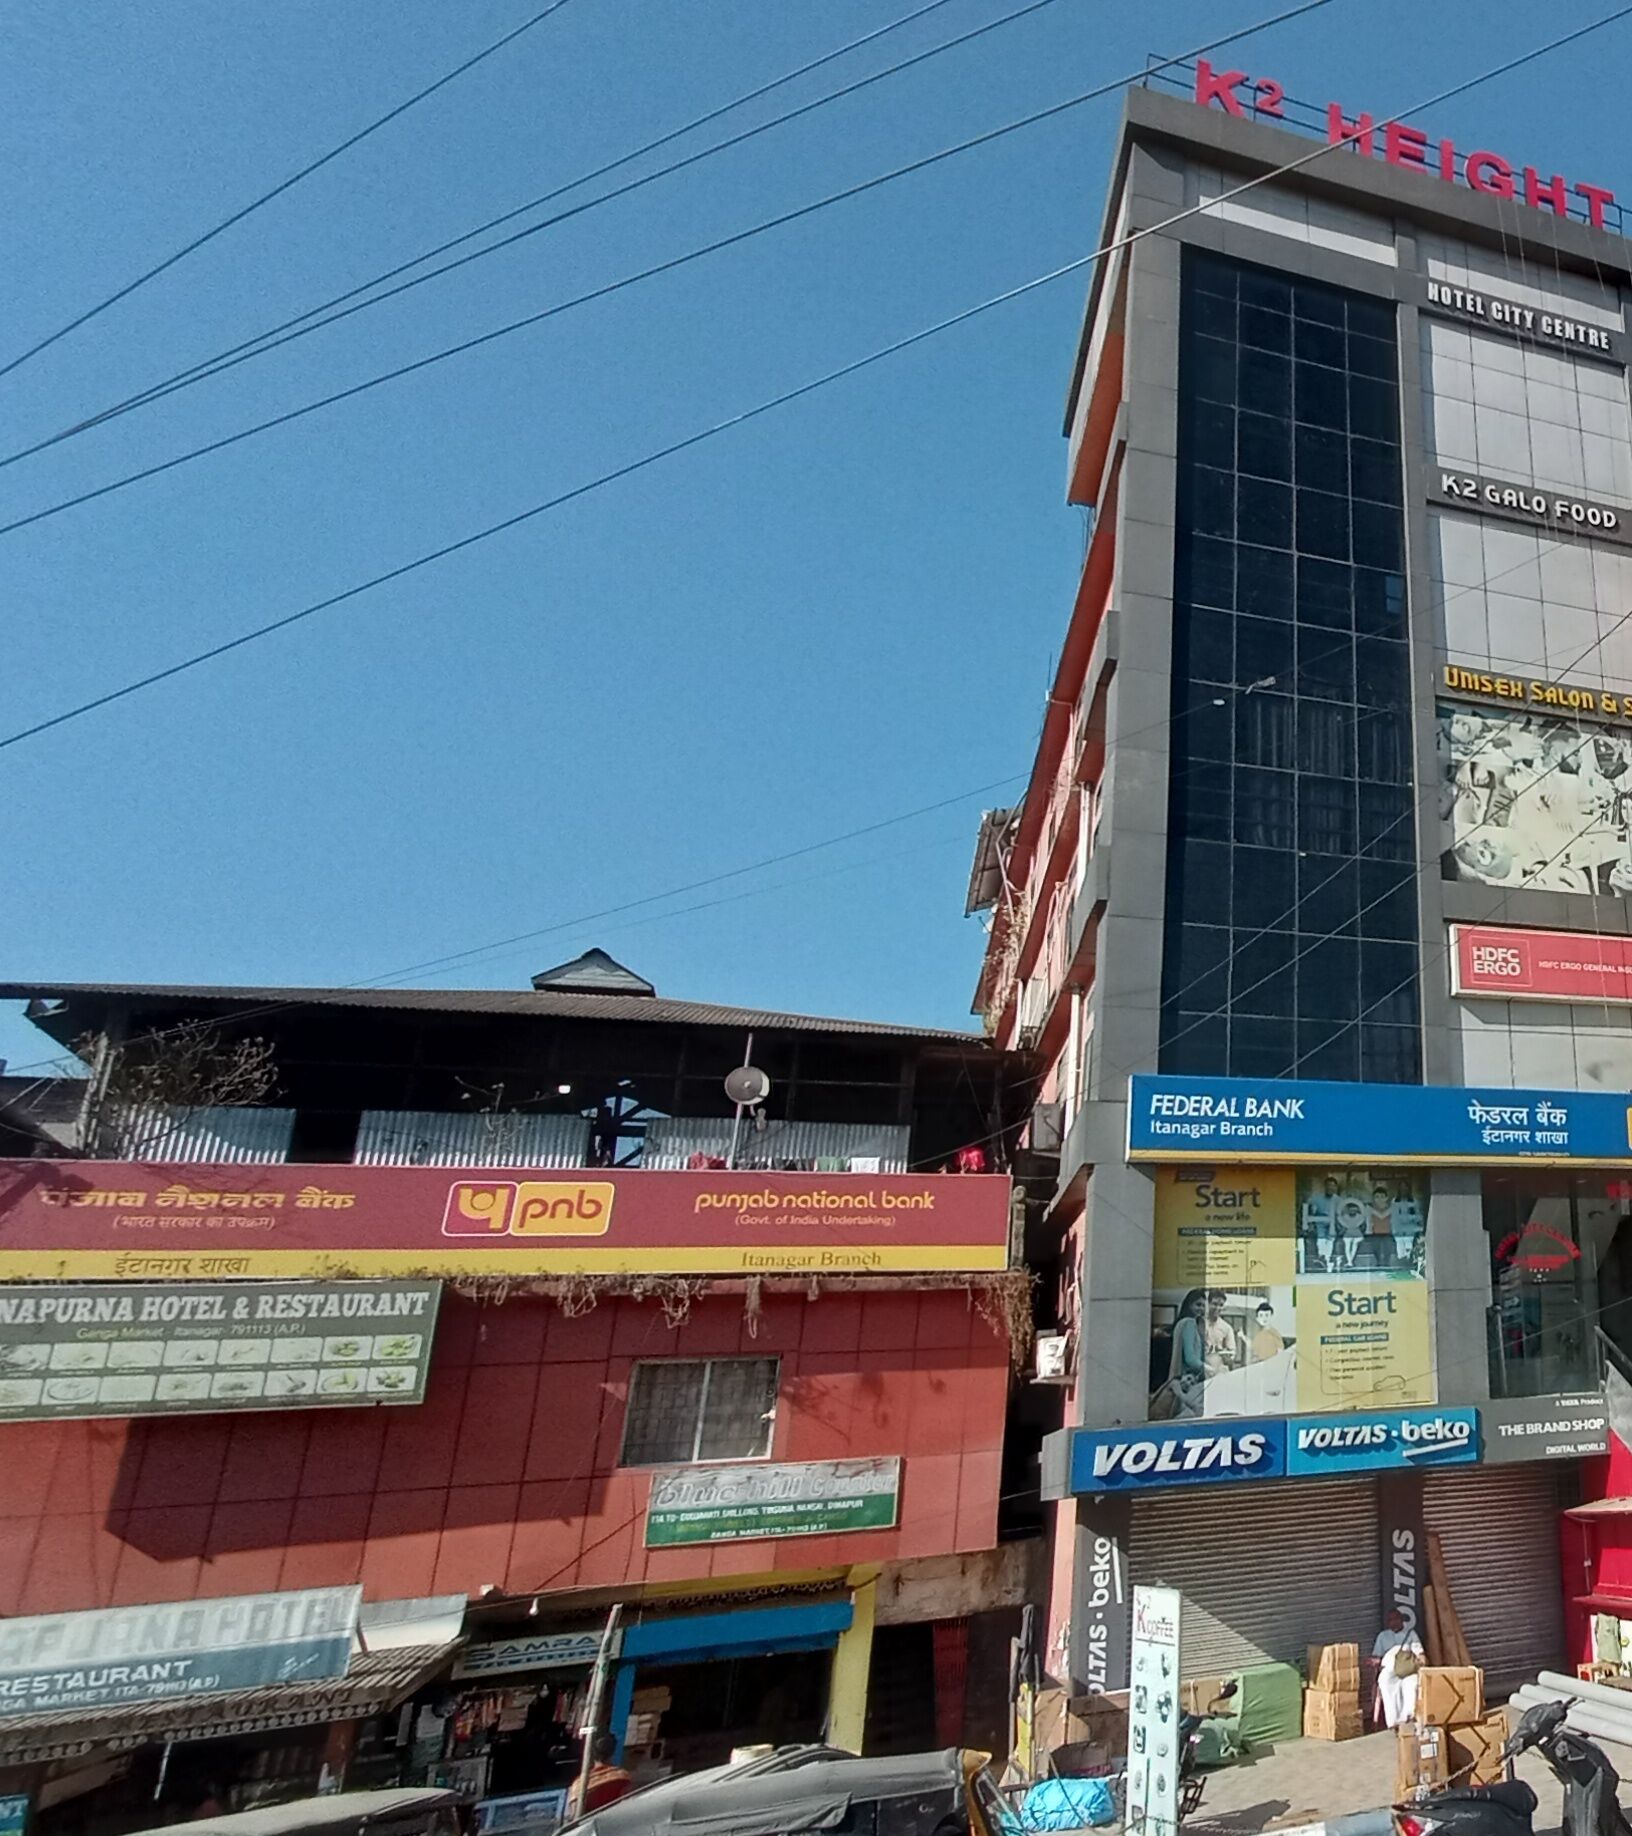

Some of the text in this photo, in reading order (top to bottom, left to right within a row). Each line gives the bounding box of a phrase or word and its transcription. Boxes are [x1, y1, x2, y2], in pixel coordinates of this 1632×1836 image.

[1329, 101, 1614, 230] HEIGHT
[1427, 282, 1610, 350] HOTEL CITY CENTRE
[1441, 473, 1617, 528] K2 GALO FOOD
[1529, 681, 1594, 709] SALON
[1601, 694, 1617, 713] &
[1472, 946, 1519, 963] HDFC
[1473, 962, 1521, 976] ERGO
[1150, 1094, 1305, 1119] FEDERAL BANK
[1467, 1099, 1568, 1127] फेडरल बैंक
[1151, 1120, 1273, 1139] Itanagar Branch
[1534, 1130, 1568, 1145] शाखा
[39, 1184, 356, 1210] पंजाब नैशनल बैंक
[517, 1188, 604, 1229] pnb
[694, 1189, 935, 1214] punjab national bank
[1195, 1184, 1261, 1208] Start
[734, 1213, 897, 1229] (Govt. of India Undertaking)
[199, 1257, 251, 1274] शाखा
[741, 1250, 882, 1270] Itanagar Branch
[0, 1292, 431, 1323] NAPURNA HOTEL & RESTAURANT
[1328, 1289, 1397, 1316] Start
[1297, 1418, 1471, 1450] VOLTAS beko
[1498, 1418, 1605, 1437] THE BRAND SHOP
[1092, 1433, 1267, 1477] VOLTAS
[1546, 1442, 1606, 1454] DIGITAL WORLD
[1392, 1528, 1416, 1629] OLTAS
[1086, 1535, 1111, 1696] OLTAS beko
[470, 1636, 597, 1662] SAMRA
[0, 1659, 193, 1697] RESTAURANT
[34, 1688, 111, 1706] MARKET
